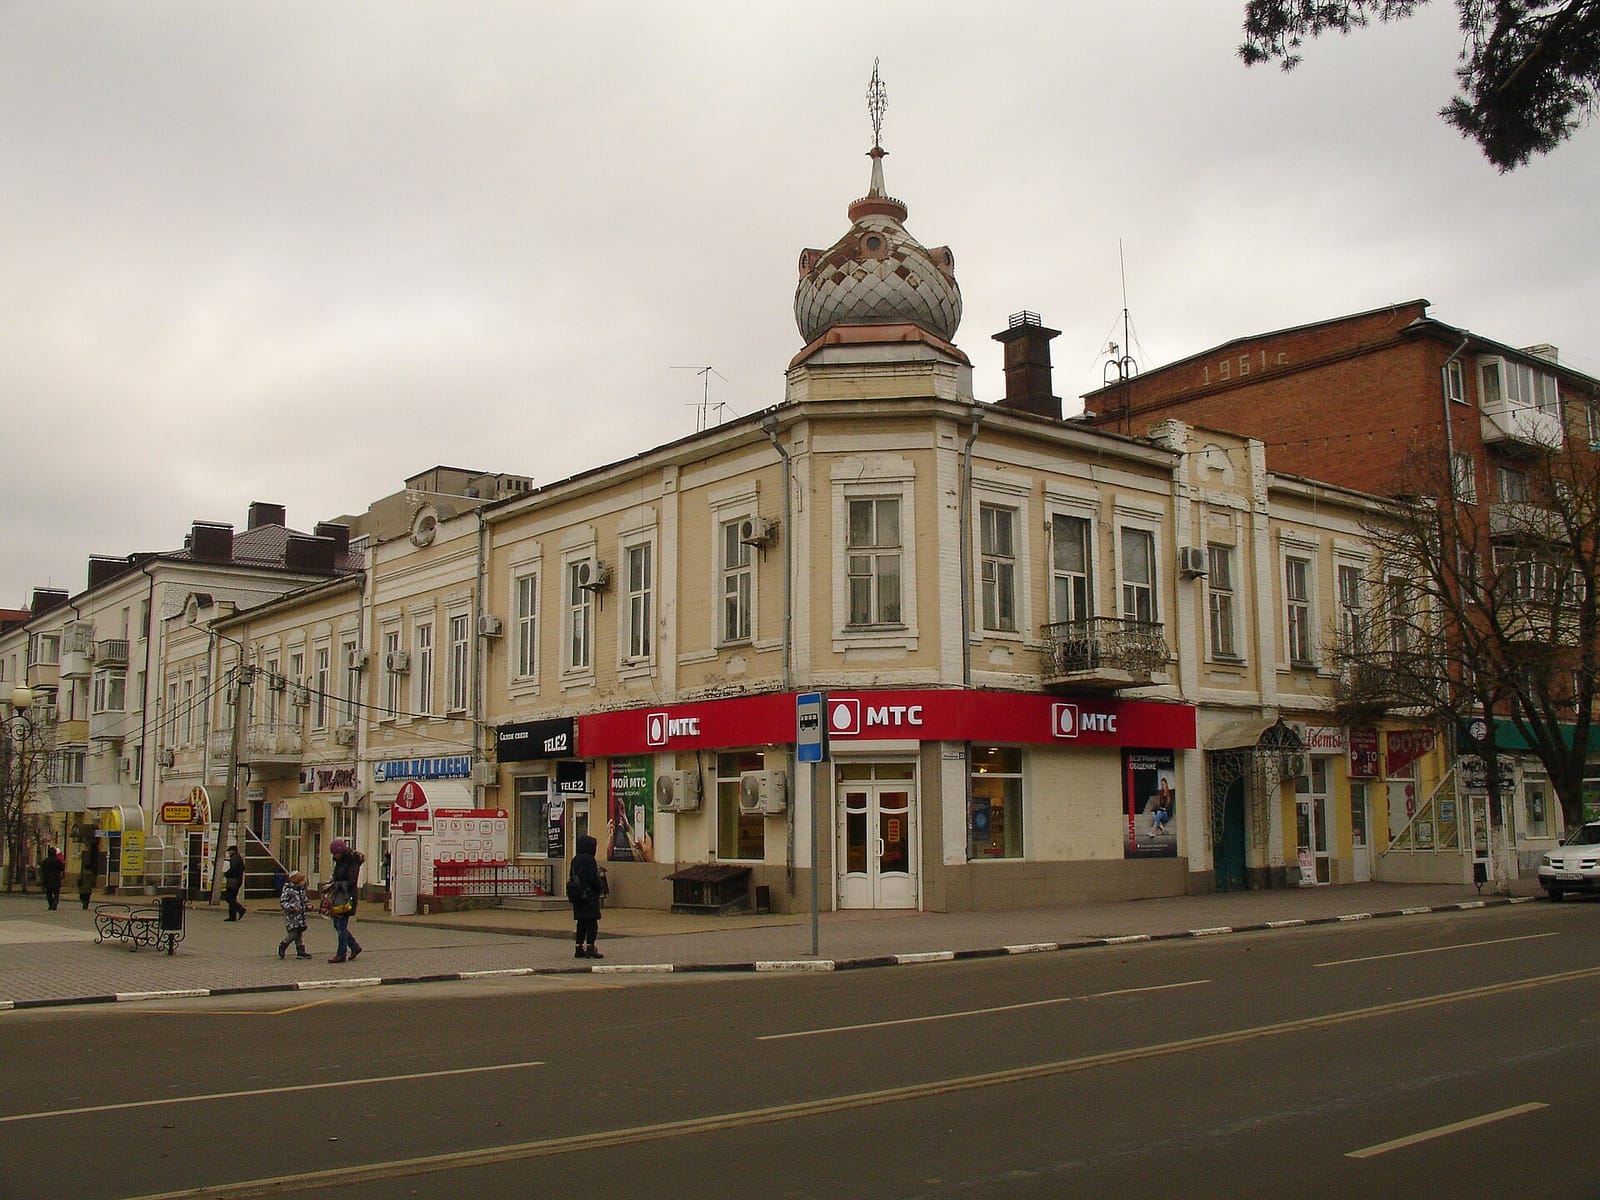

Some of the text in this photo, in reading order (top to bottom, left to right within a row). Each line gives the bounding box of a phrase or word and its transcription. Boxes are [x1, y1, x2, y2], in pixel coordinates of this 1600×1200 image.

[867, 705, 923, 726] МТС
[1080, 712, 1117, 733] МТС
[668, 717, 700, 737] МТС
[544, 733, 567, 752] TELE2
[1388, 732, 1434, 753] ФОТО
[560, 780, 584, 791] TELE2
[612, 775, 647, 789] МОЙ МТС
